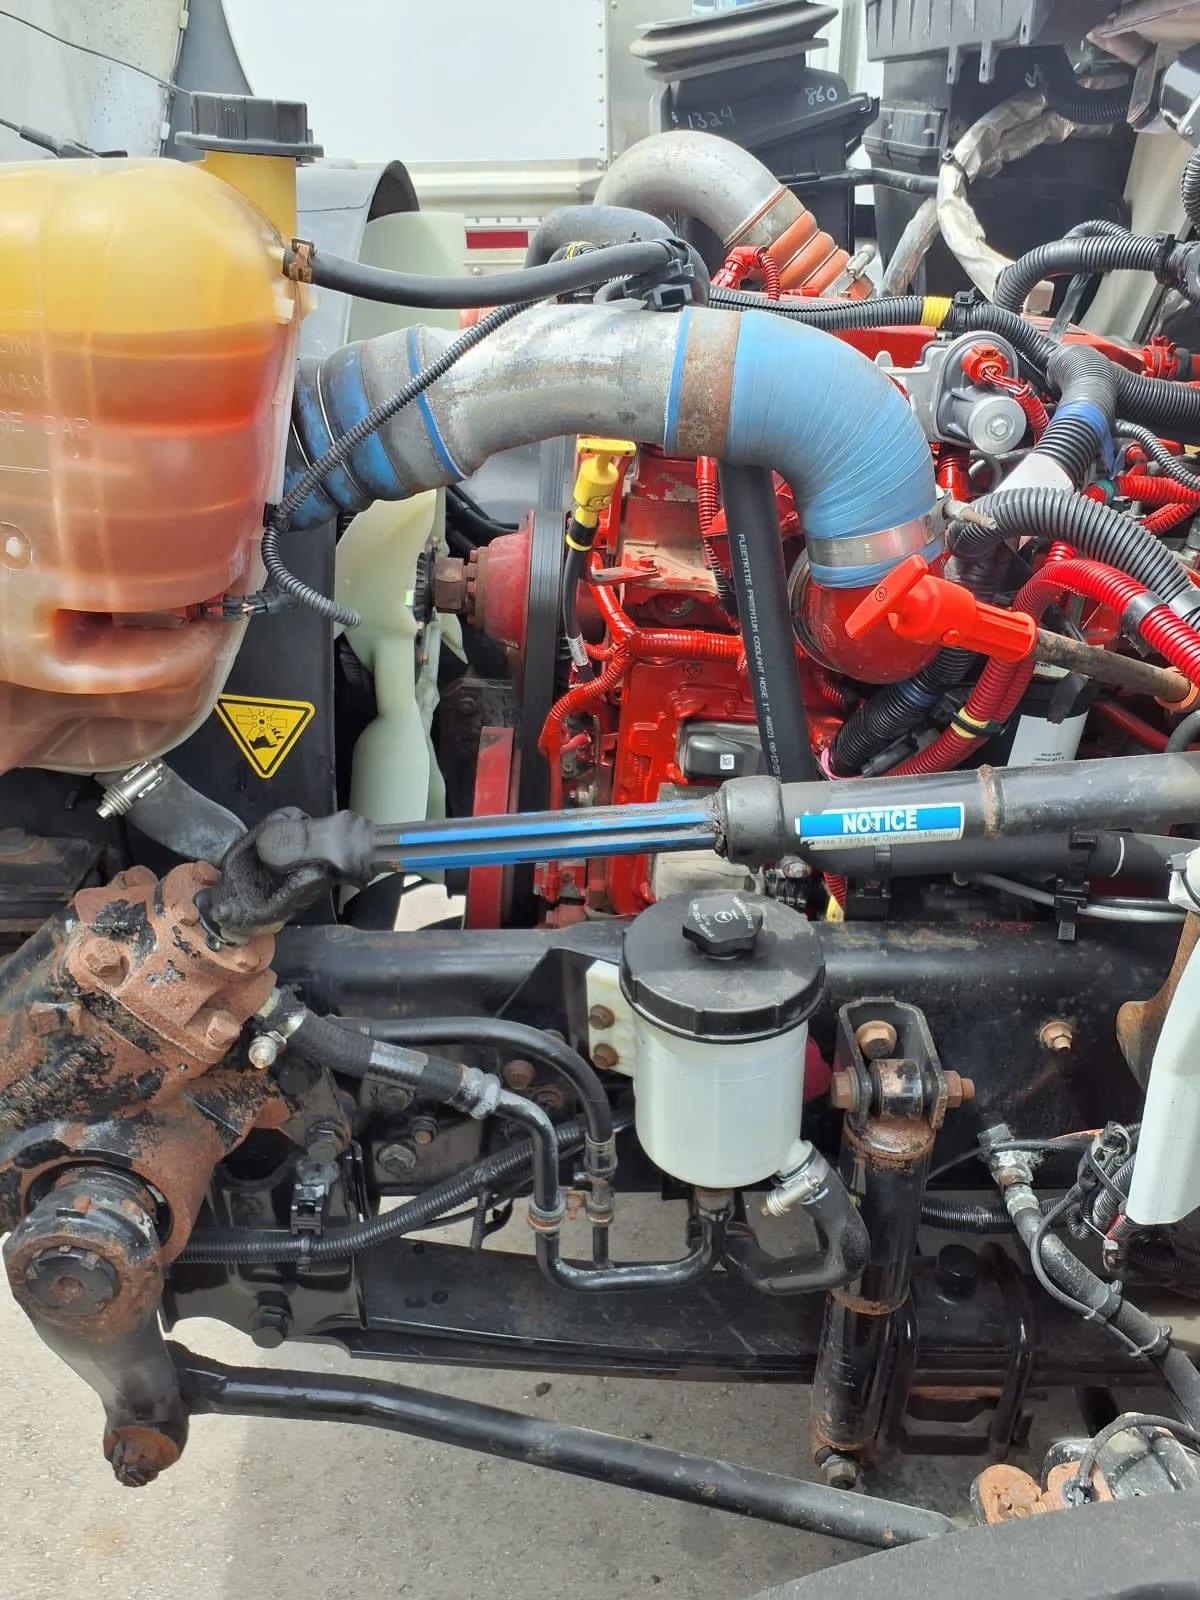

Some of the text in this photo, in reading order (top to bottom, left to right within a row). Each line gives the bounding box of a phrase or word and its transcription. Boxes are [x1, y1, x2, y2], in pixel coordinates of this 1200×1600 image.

[804, 85, 838, 105] 860
[687, 105, 736, 129] 1324
[737, 533, 753, 586] FLEETRITE
[753, 635, 765, 673] COOLANT
[759, 676, 769, 700] HOSE
[842, 808, 918, 834] NOTICE
